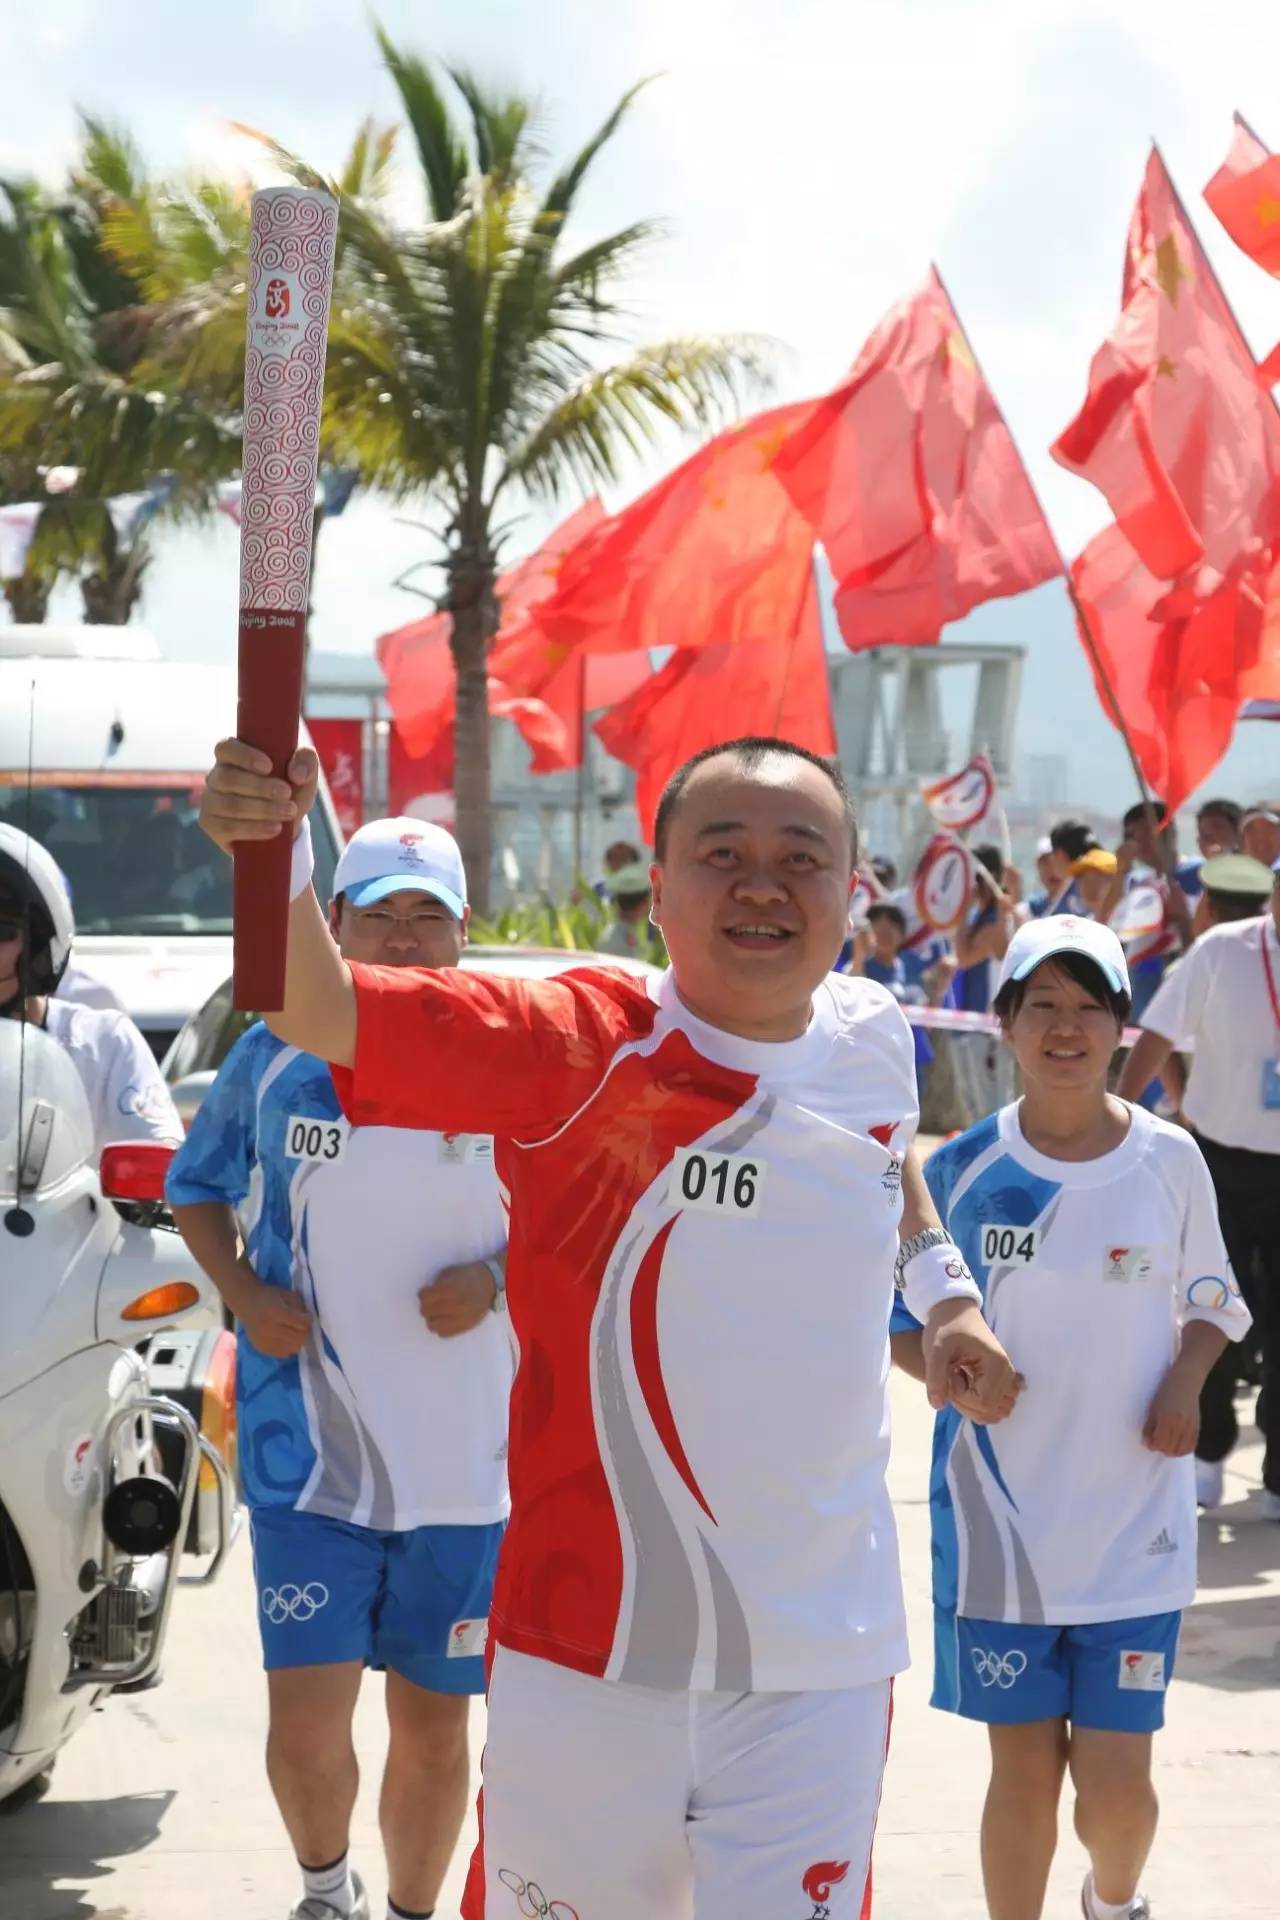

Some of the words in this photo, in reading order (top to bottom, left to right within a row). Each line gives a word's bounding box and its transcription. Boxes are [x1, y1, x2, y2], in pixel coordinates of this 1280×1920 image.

[269, 615, 296, 628] 2008
[292, 1123, 341, 1160] 003
[682, 1154, 758, 1209] 016
[985, 1229, 1035, 1263] 004
